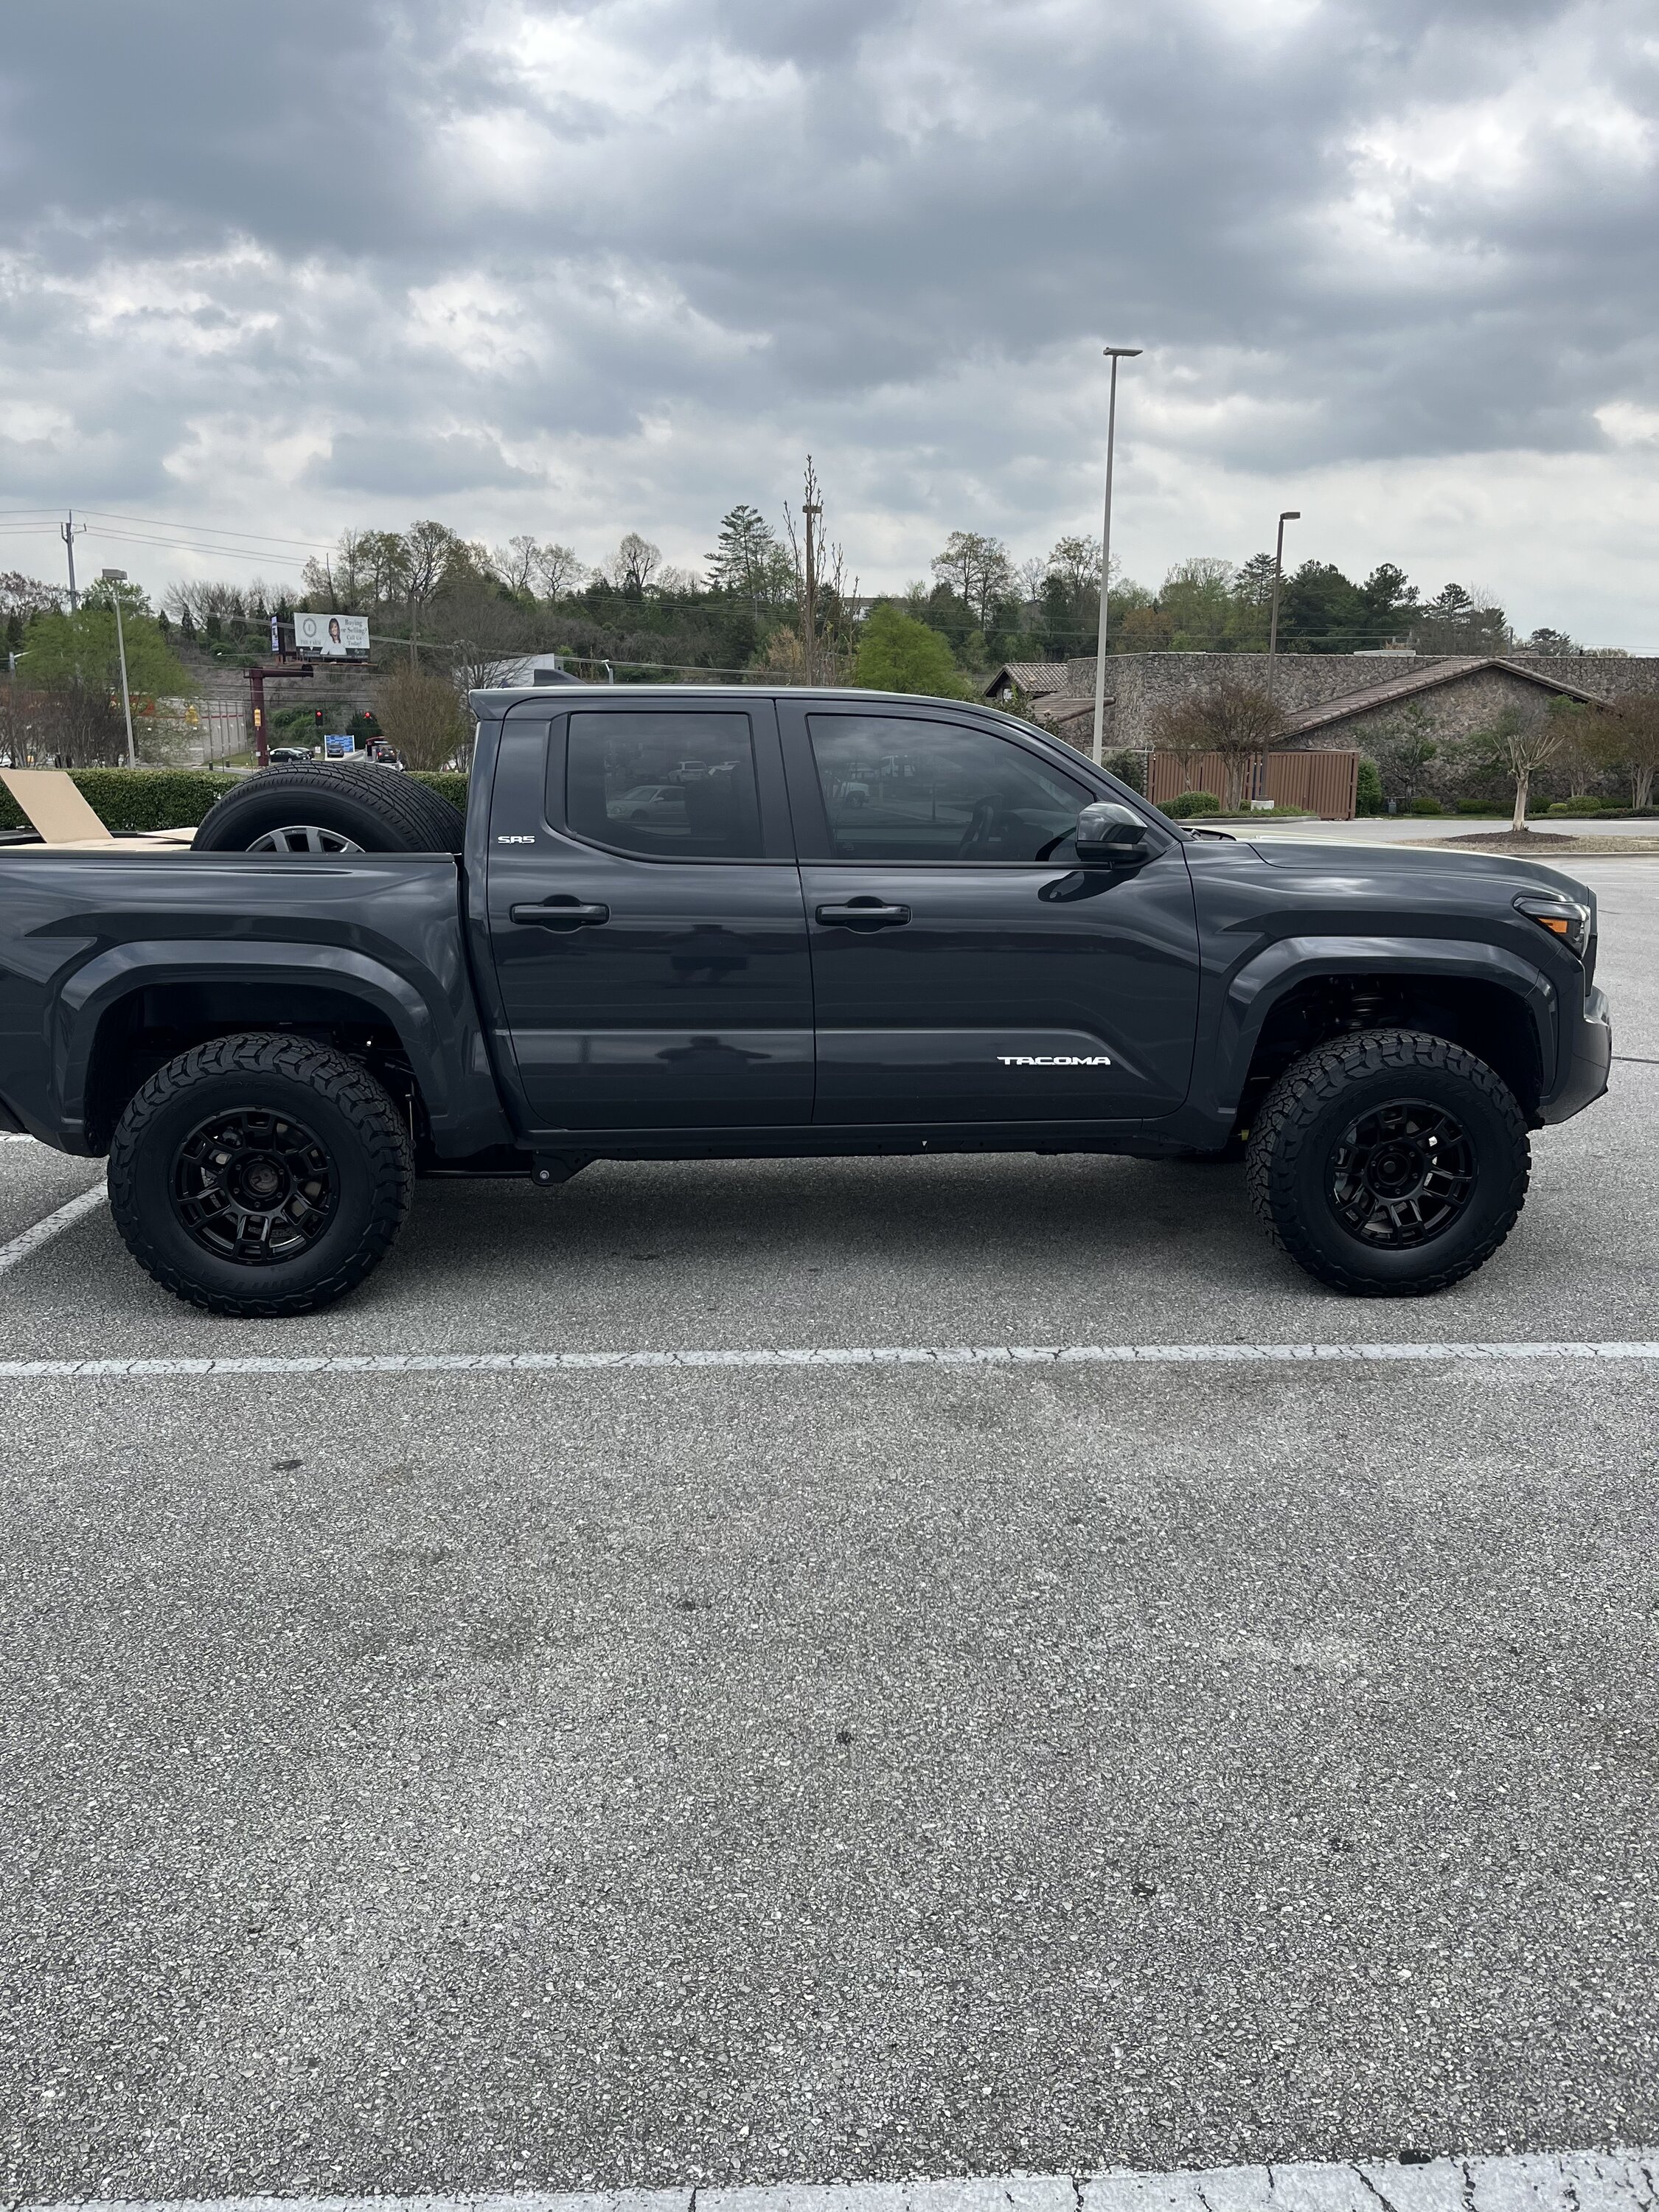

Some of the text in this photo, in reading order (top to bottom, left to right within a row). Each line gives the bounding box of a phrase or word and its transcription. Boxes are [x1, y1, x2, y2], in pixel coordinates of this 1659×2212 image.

[345, 619, 363, 627] Buying
[347, 626, 367, 636] Selling?
[498, 835, 535, 844] SR5
[997, 1056, 1111, 1065] TACOMA
